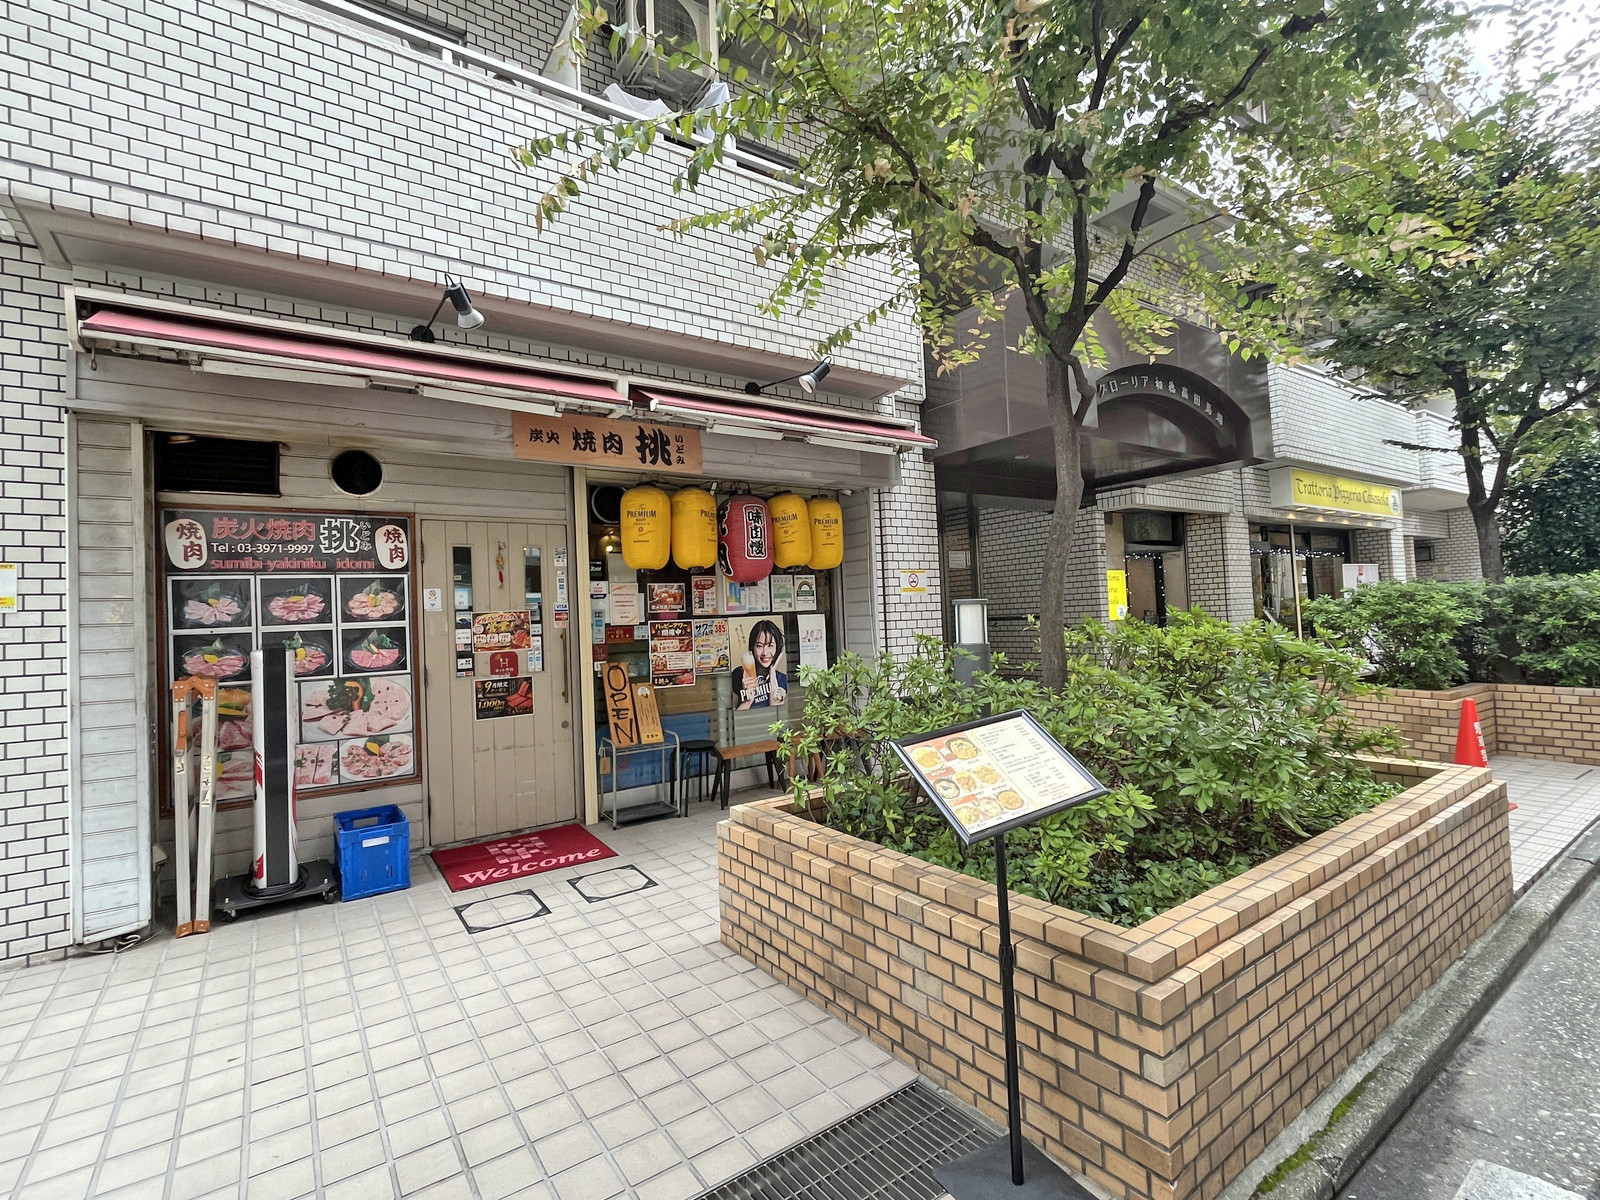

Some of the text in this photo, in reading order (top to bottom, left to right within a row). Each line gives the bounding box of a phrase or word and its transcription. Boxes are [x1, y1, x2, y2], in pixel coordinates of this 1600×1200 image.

[529, 426, 672, 466] 炭火 焼肉 挑
[675, 434, 686, 464] いどみ
[1296, 478, 1332, 498] Trattoria
[1334, 485, 1361, 504] Pizzeria
[212, 516, 361, 554] 炭火焼肉 挑
[747, 506, 764, 556] 味自慢
[772, 513, 798, 524] PREMIUM
[176, 522, 204, 562] 焼肉
[211, 542, 228, 552] Tel
[237, 543, 314, 554] 03-3971-9997
[384, 528, 405, 563] 焼肉
[210, 556, 375, 573] sumibi-yakiniku idomi
[608, 665, 633, 744] OPEN
[458, 848, 601, 884] Welcome
